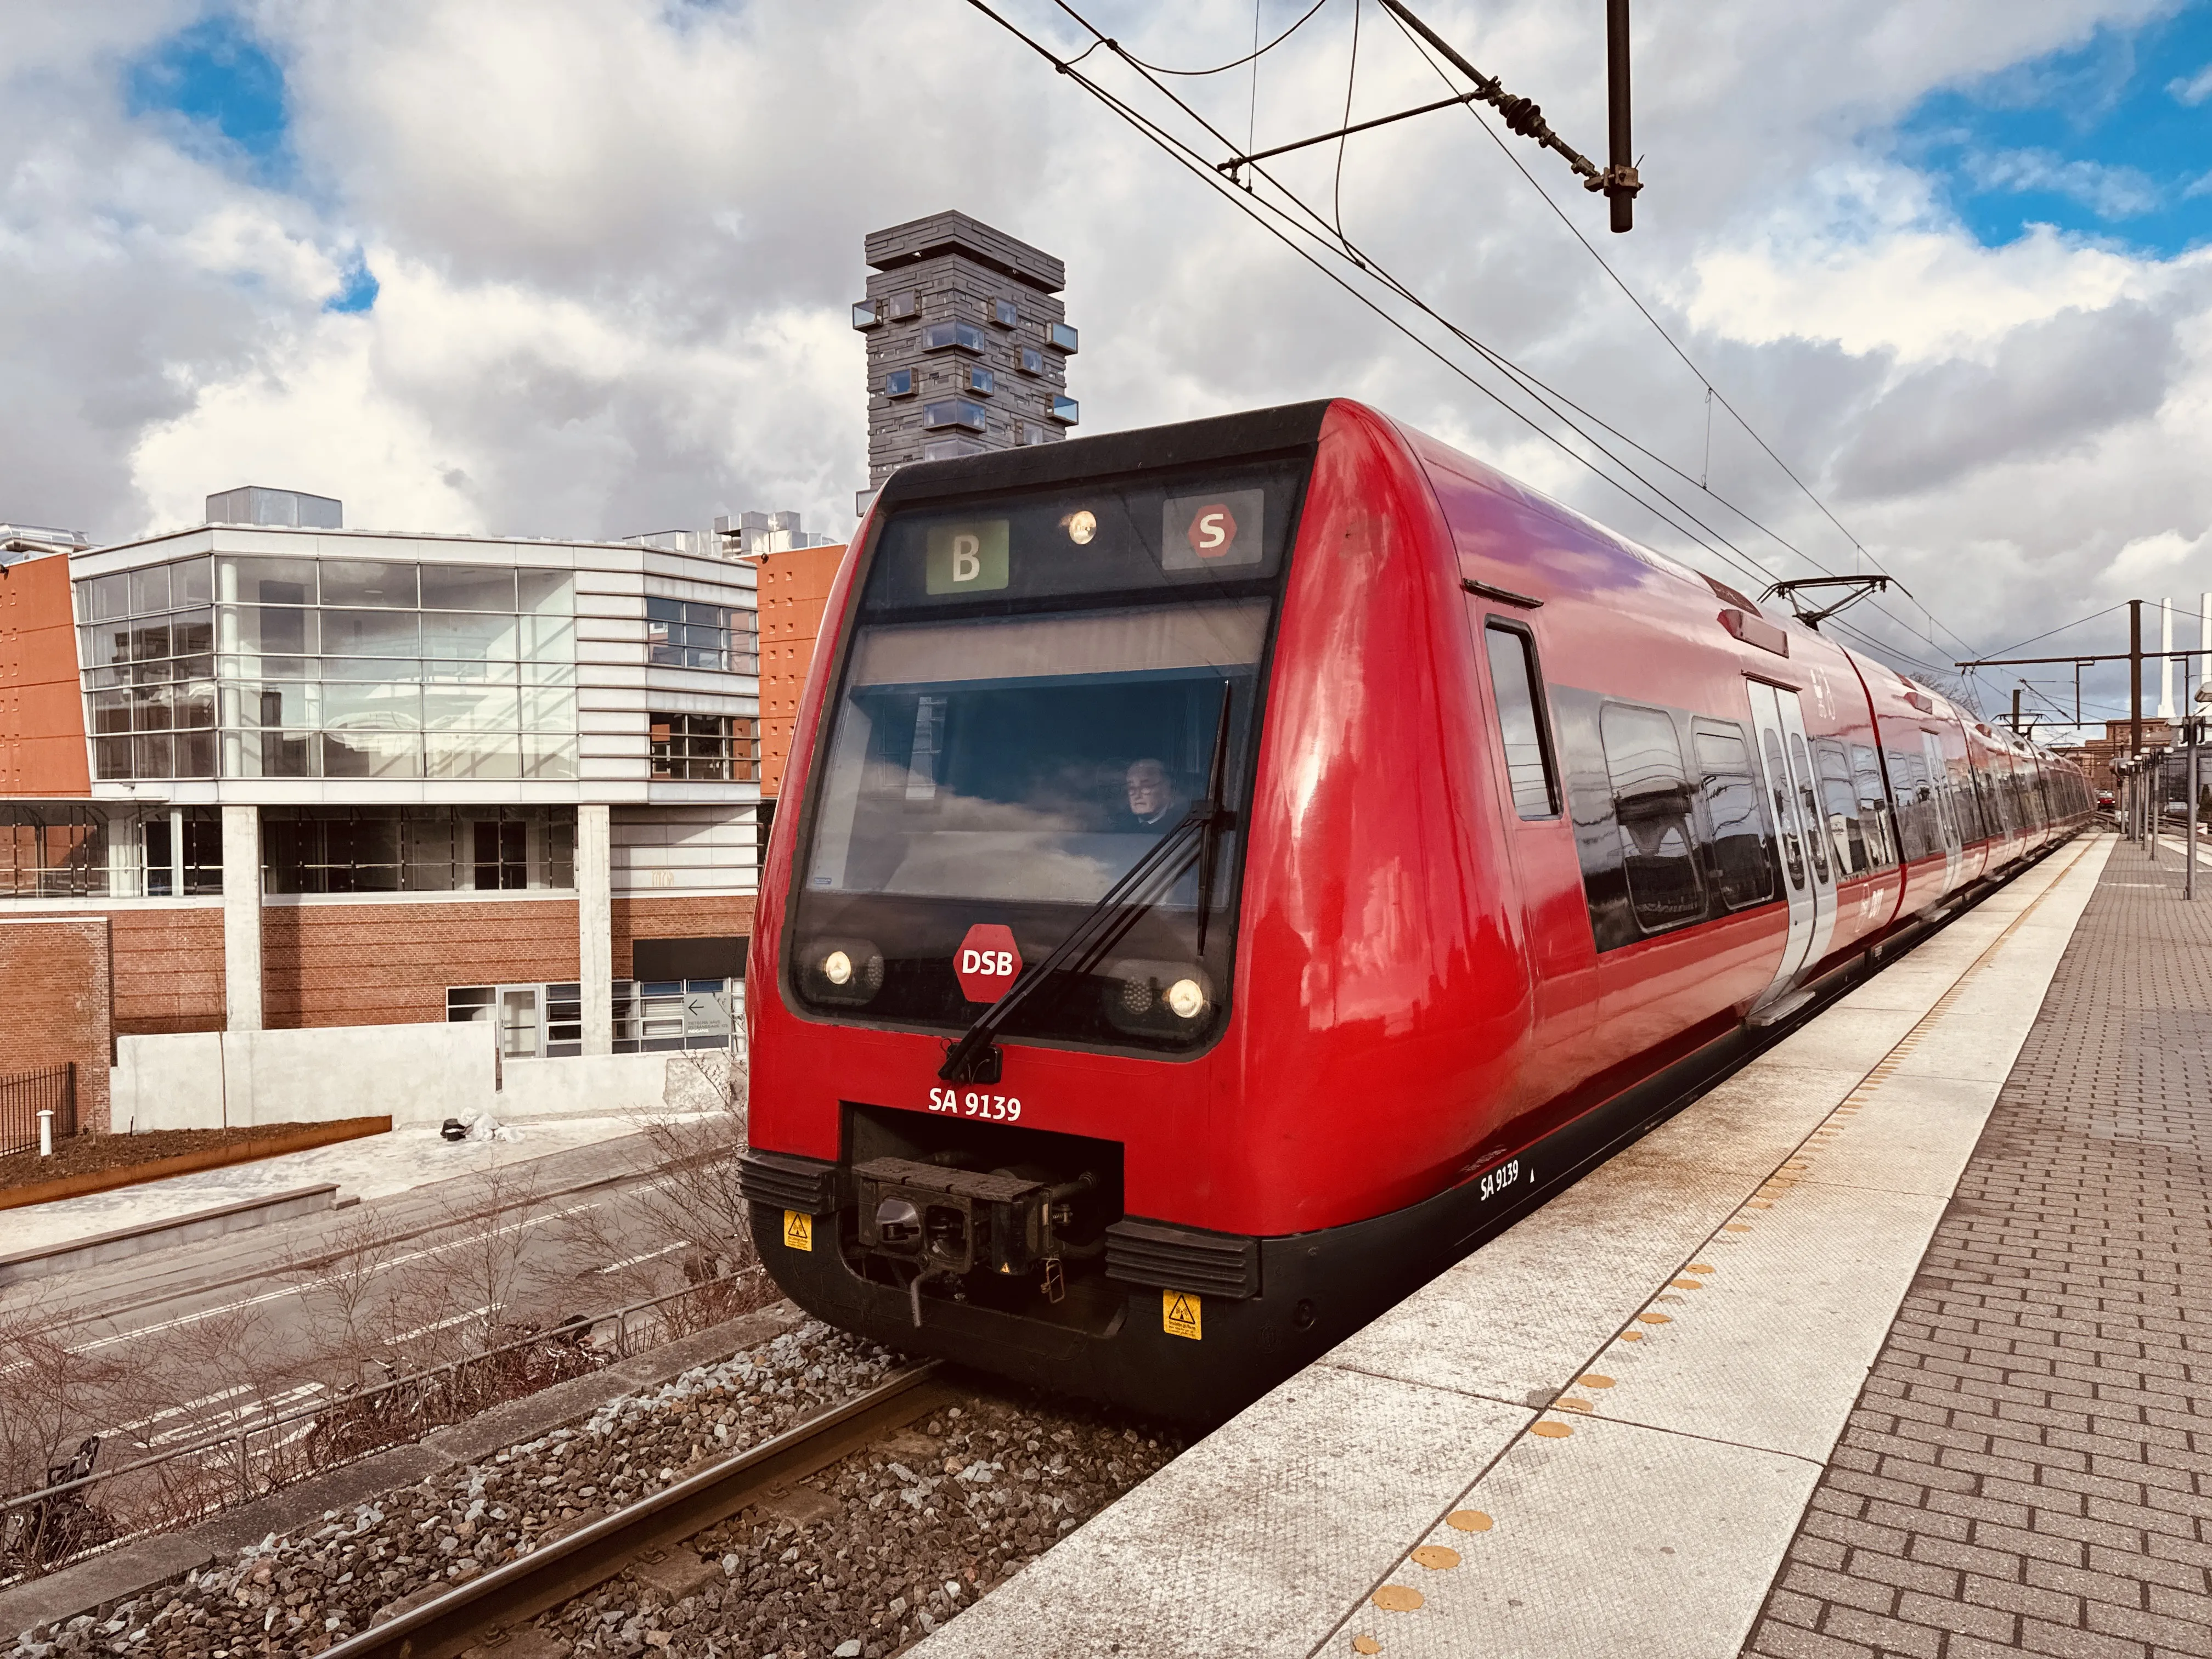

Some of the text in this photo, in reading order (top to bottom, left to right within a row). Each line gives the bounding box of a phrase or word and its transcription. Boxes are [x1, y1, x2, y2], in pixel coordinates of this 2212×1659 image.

[1200, 514, 1225, 548] S
[953, 535, 980, 582] B
[962, 950, 1013, 976] DSB
[928, 1087, 1021, 1121] SA 9139
[1481, 1159, 1519, 1201] SA 9139
